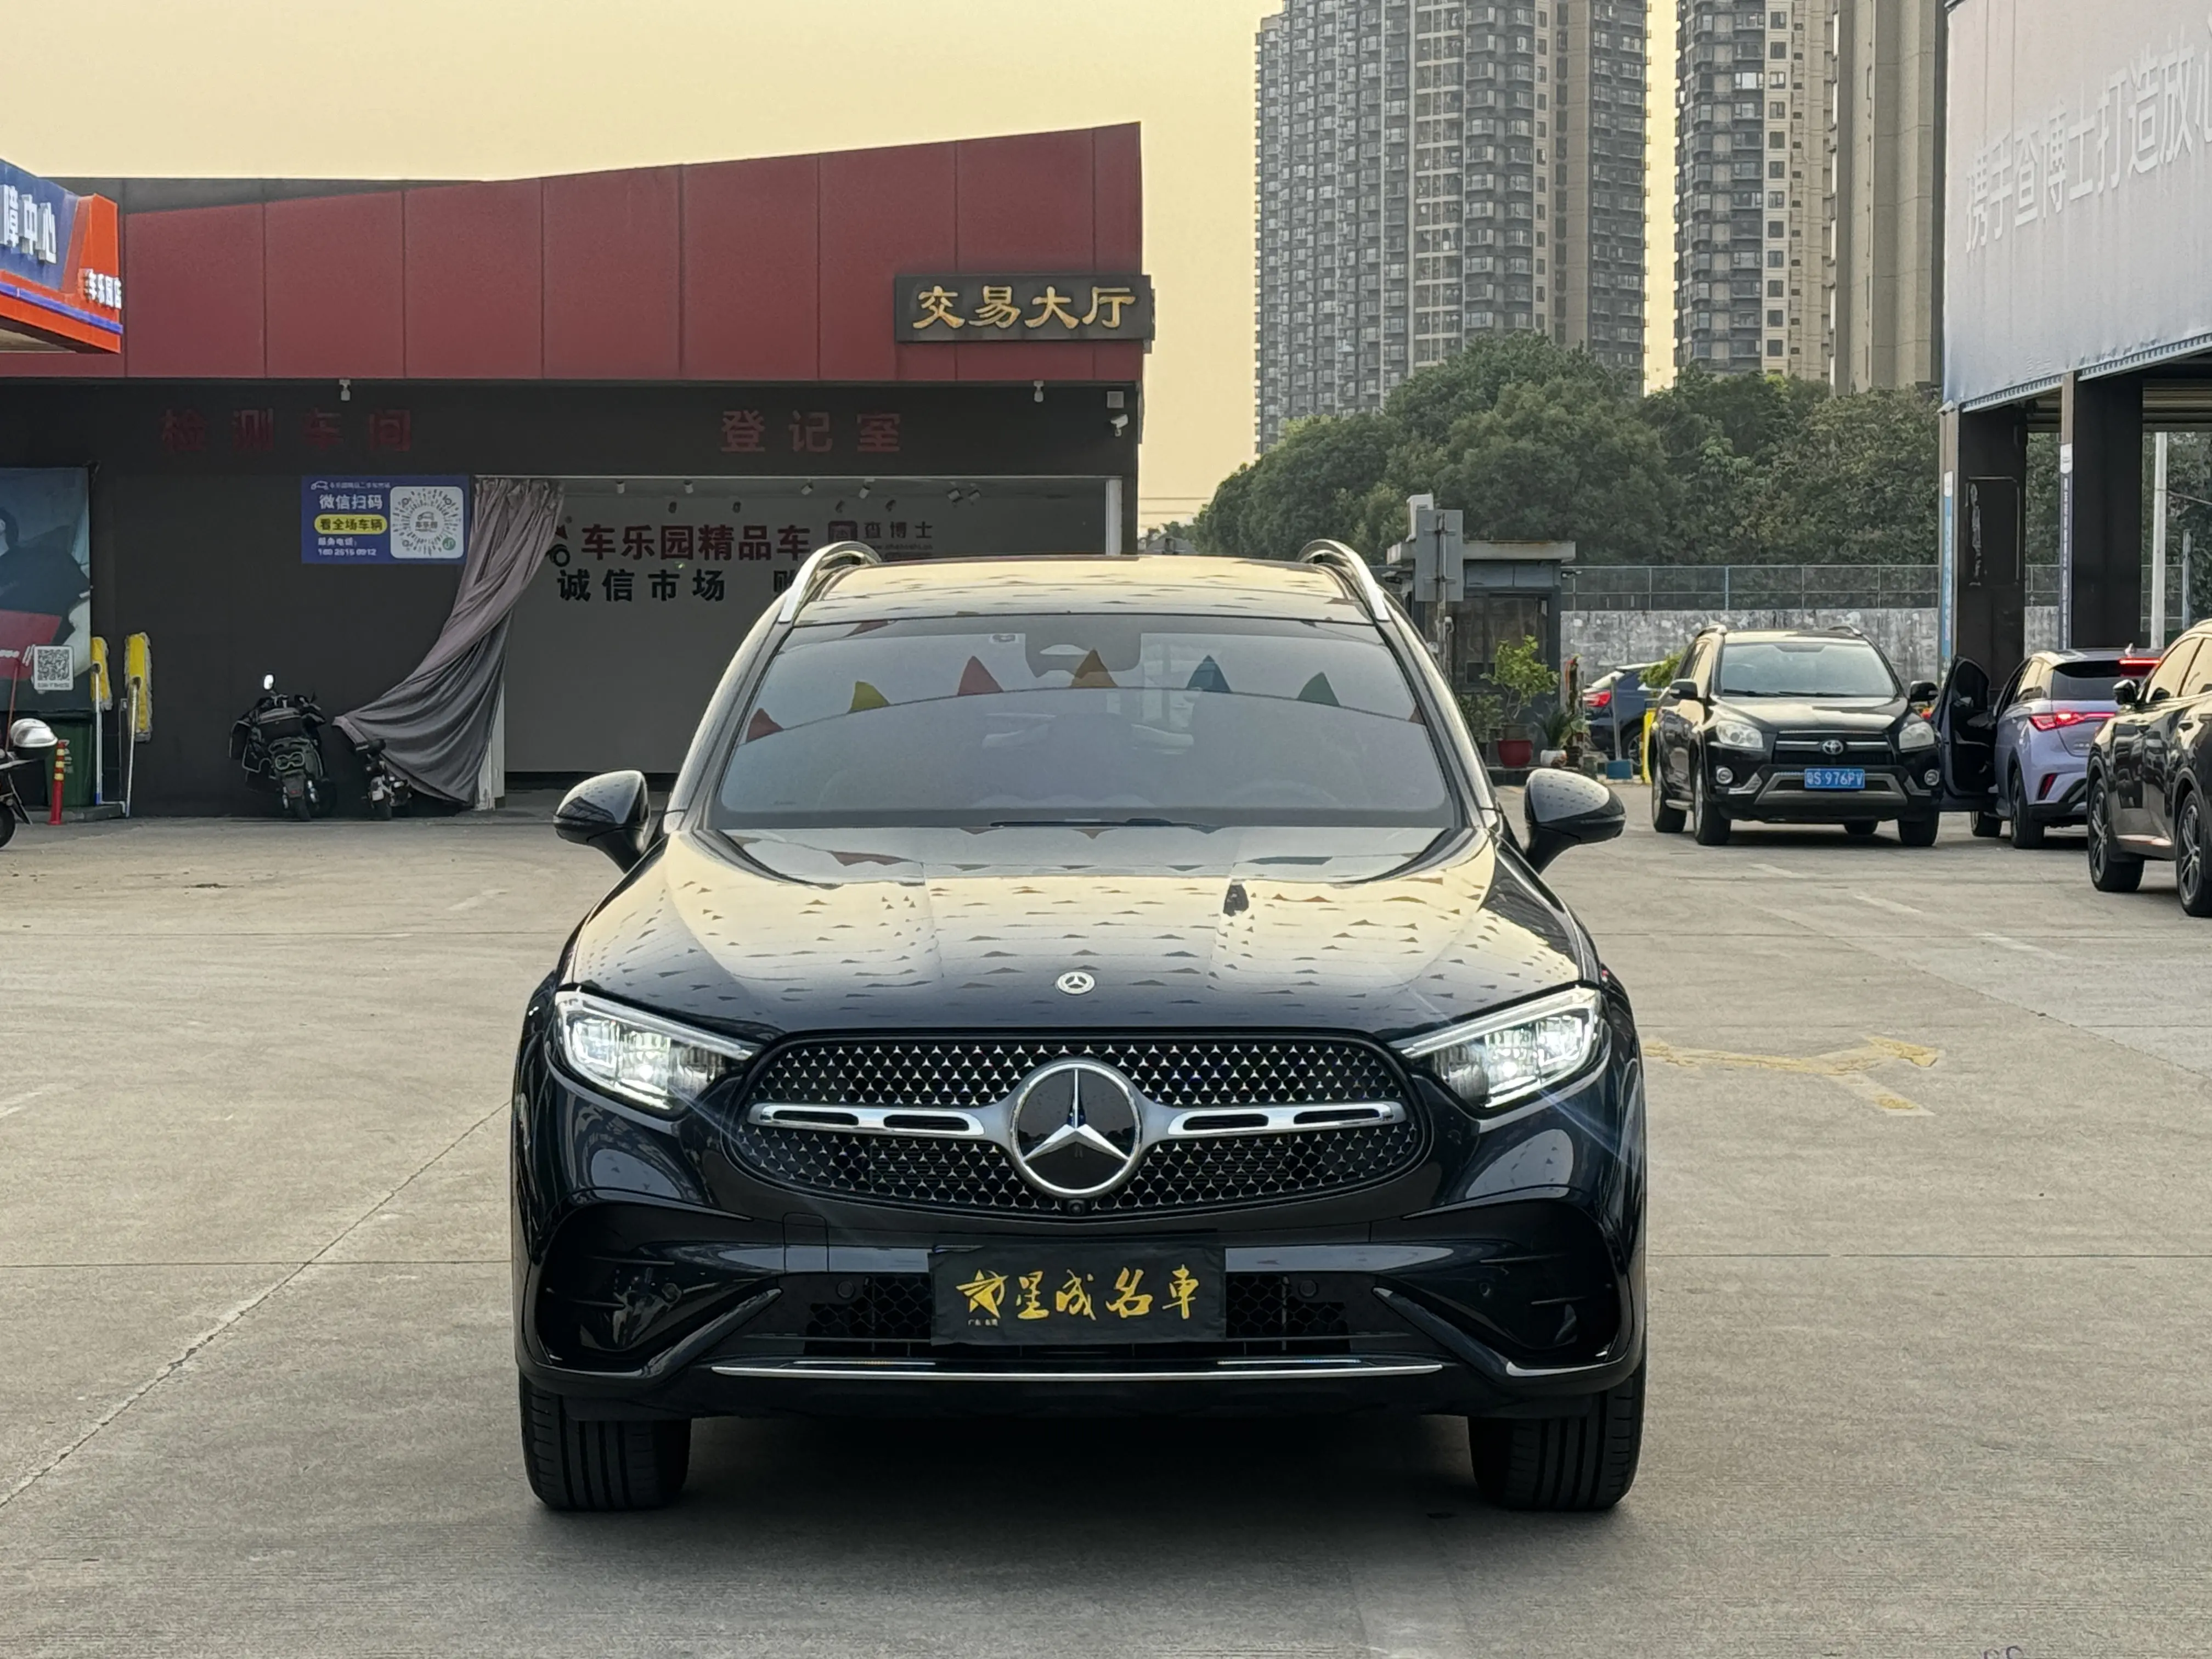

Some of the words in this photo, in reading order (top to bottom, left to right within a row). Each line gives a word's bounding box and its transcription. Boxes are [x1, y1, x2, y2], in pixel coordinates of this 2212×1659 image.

[912, 285, 1136, 329] 交易大厅
[160, 408, 411, 453] 检测车间
[721, 410, 901, 452] 登记室
[319, 494, 382, 510] 微信扫码
[320, 518, 383, 531] 看全场车辆
[582, 524, 811, 561] 车乐园精品车
[557, 569, 725, 602] 诚信市场
